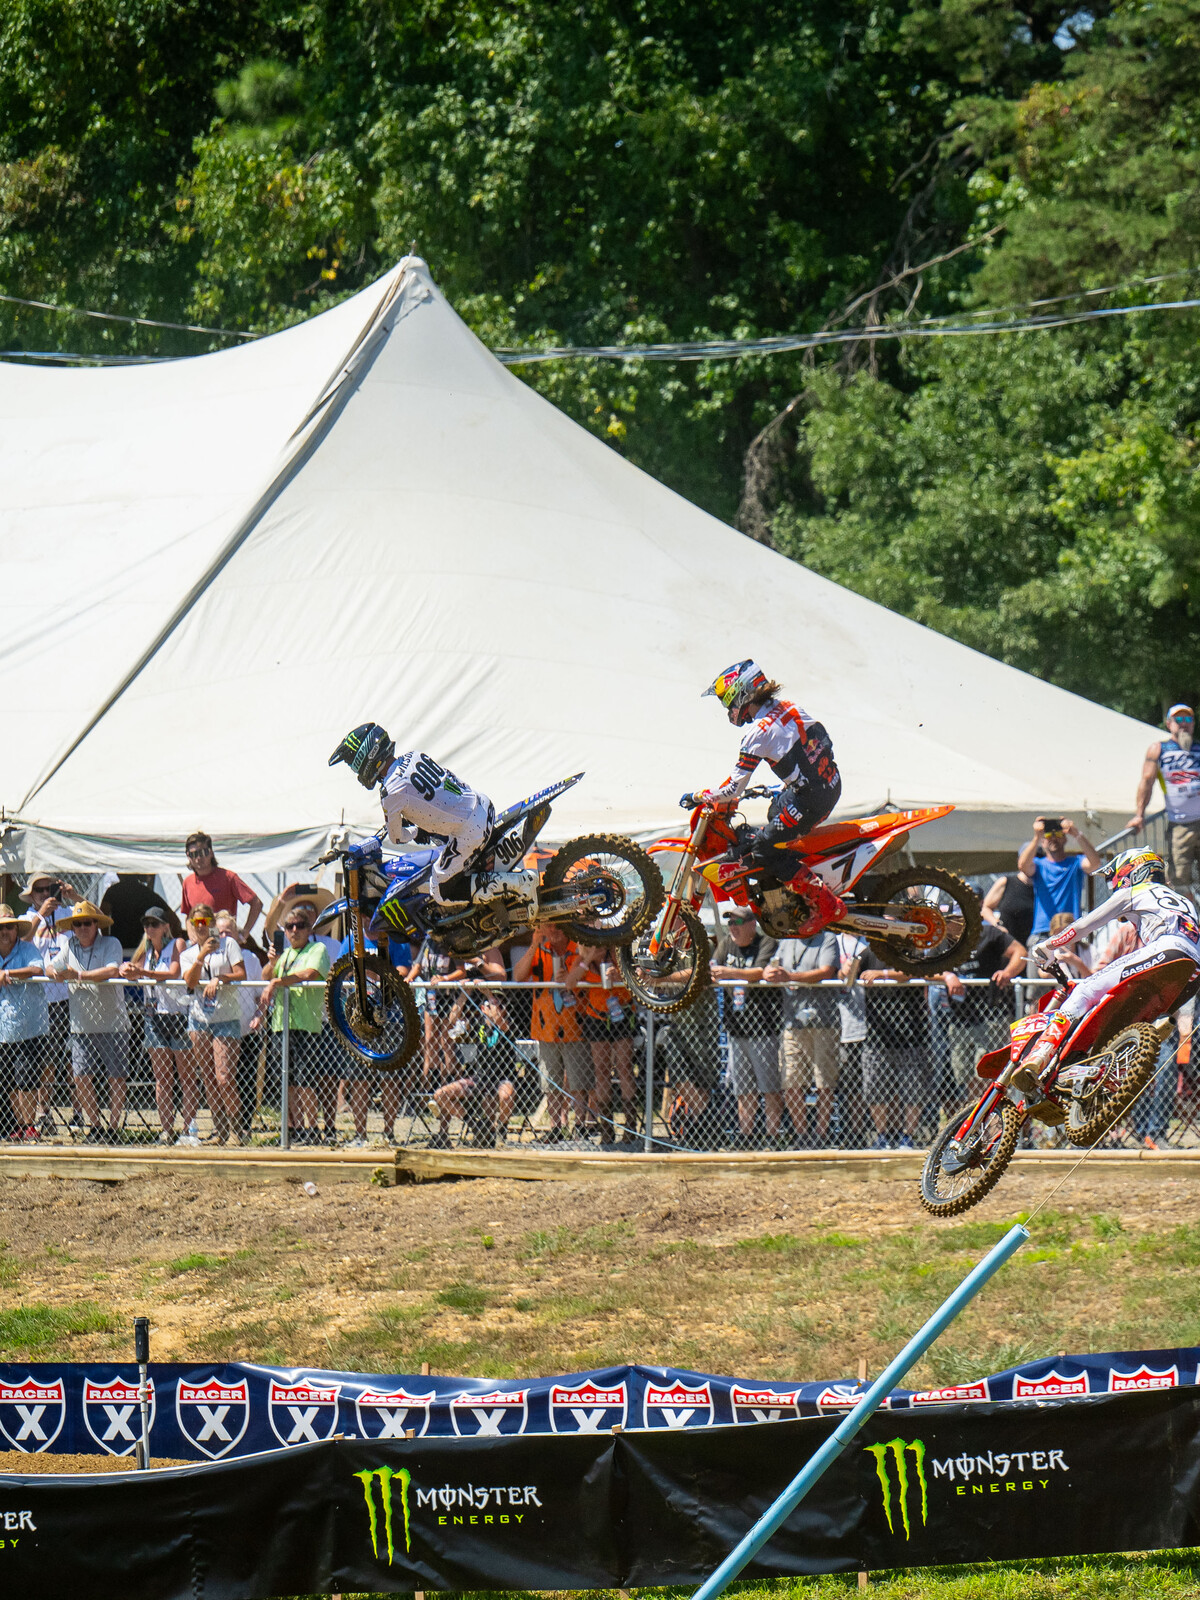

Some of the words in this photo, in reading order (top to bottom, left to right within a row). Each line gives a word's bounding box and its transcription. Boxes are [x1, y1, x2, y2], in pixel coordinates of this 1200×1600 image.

[410, 752, 445, 802] 906
[494, 830, 525, 866] 906
[831, 850, 856, 884] 7
[1121, 951, 1167, 979] GASGAS
[1020, 1383, 1084, 1395] RACER
[1114, 1377, 1172, 1390] RACER
[1, 1389, 59, 1400] RACER
[183, 1389, 243, 1400] RACER
[274, 1390, 332, 1401] RACER
[363, 1394, 430, 1404] RACER
[555, 1393, 621, 1403] RACER
[650, 1393, 707, 1403] RACER
[736, 1394, 794, 1405] RACER
[916, 1388, 982, 1401] RACER
[15, 1404, 48, 1441] X
[101, 1404, 137, 1441] X
[196, 1405, 233, 1441] X
[286, 1406, 320, 1443] X
[375, 1407, 409, 1438] X
[931, 1449, 1070, 1481] MONSTER
[956, 1479, 1050, 1495] ENERGY
[416, 1483, 543, 1511] MONSTER
[438, 1514, 524, 1526] ENERGY
